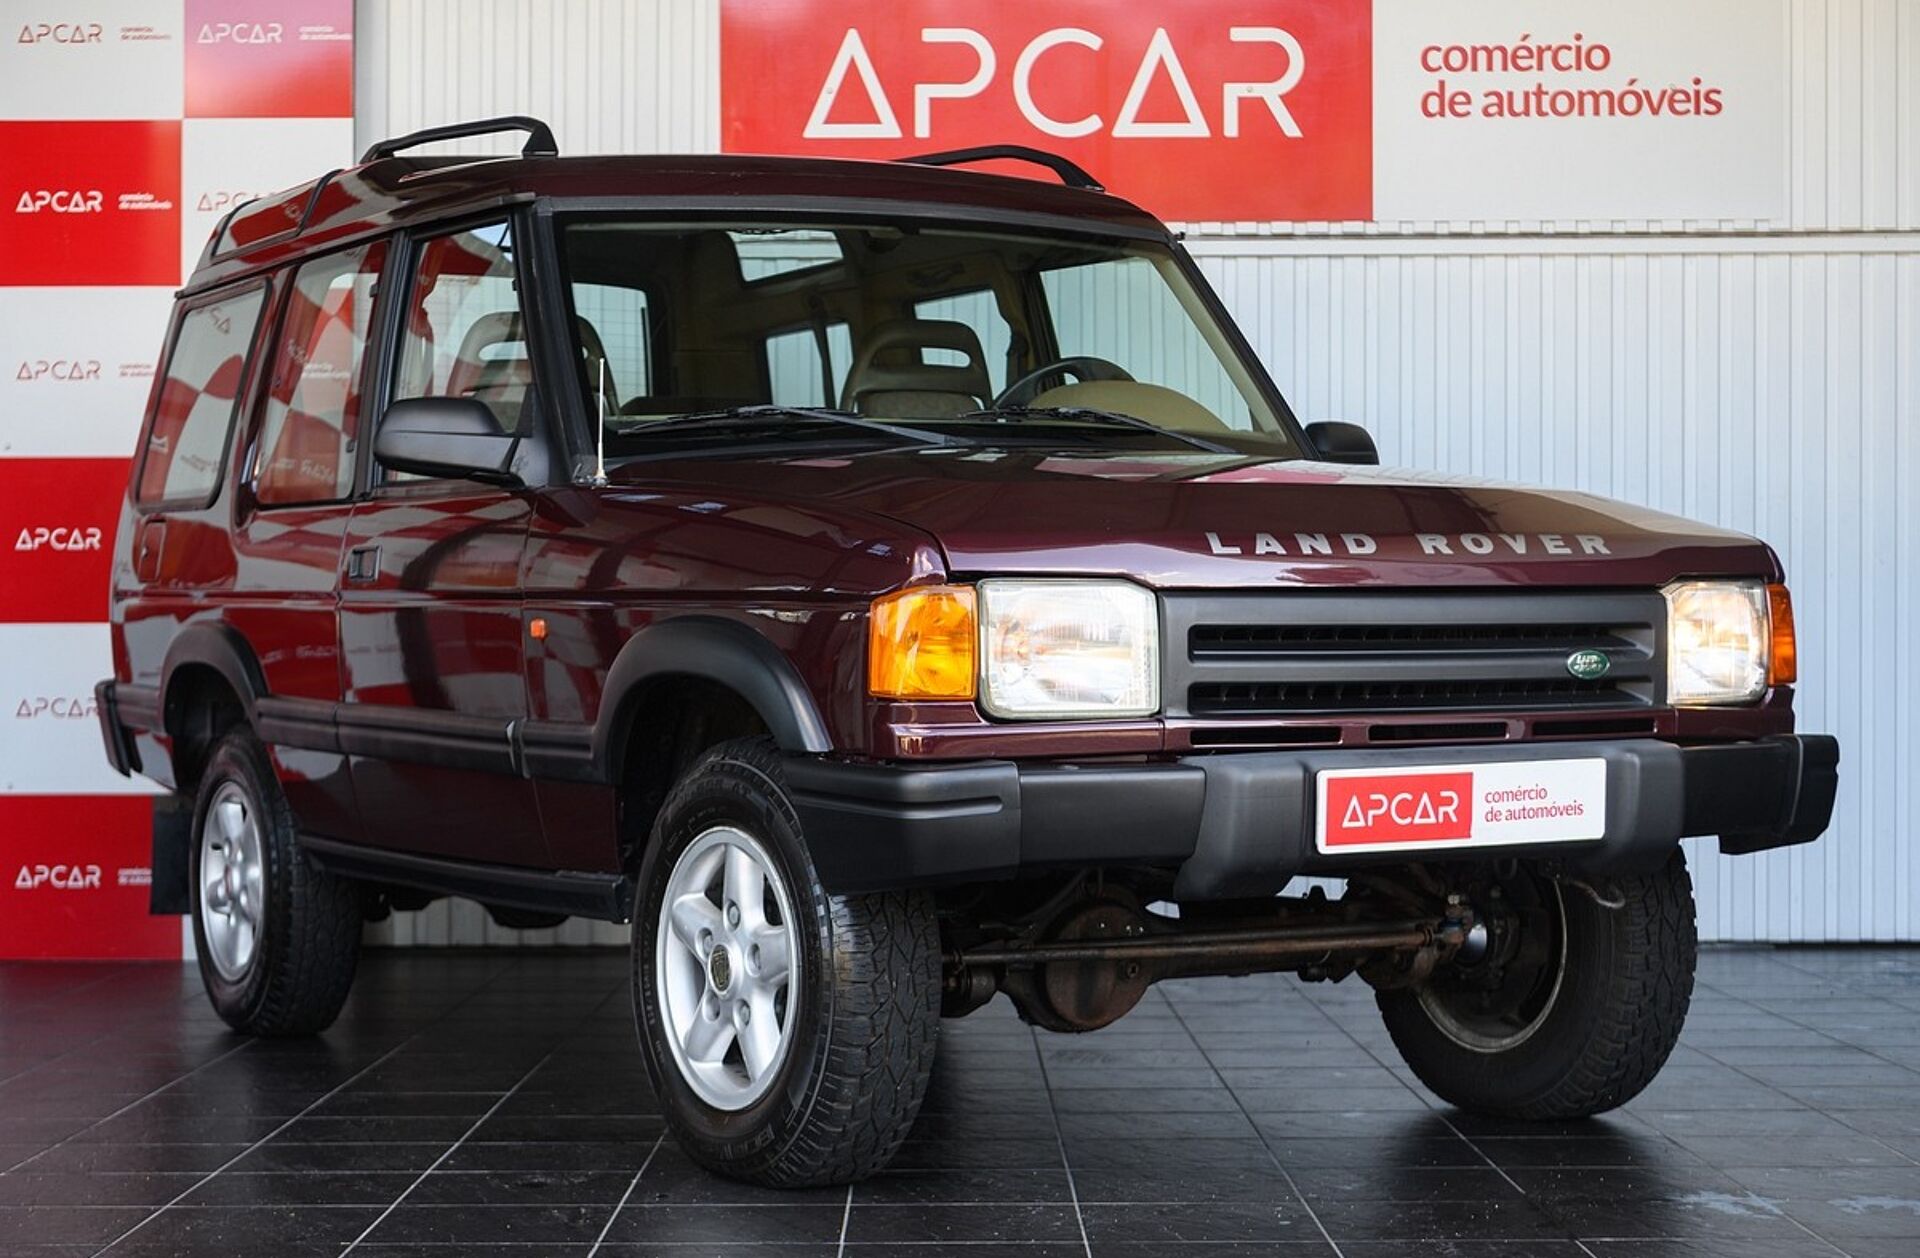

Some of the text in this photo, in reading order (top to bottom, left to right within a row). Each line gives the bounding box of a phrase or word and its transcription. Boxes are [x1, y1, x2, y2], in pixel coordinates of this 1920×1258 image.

[18, 24, 103, 43] APCAR
[197, 23, 282, 44] APCAR
[1420, 33, 1611, 73] comércio
[803, 27, 1305, 138] APCAR
[1420, 77, 1723, 118] de automóveis
[16, 190, 103, 213] APCAR
[16, 360, 101, 380] APCAR
[15, 527, 102, 551] APCAR
[1205, 532, 1611, 555] LAND ROVER
[1484, 784, 1548, 804] comércio
[1342, 791, 1460, 828] APCAR
[1484, 800, 1585, 823] de automóveis
[16, 865, 102, 889] APCAR
